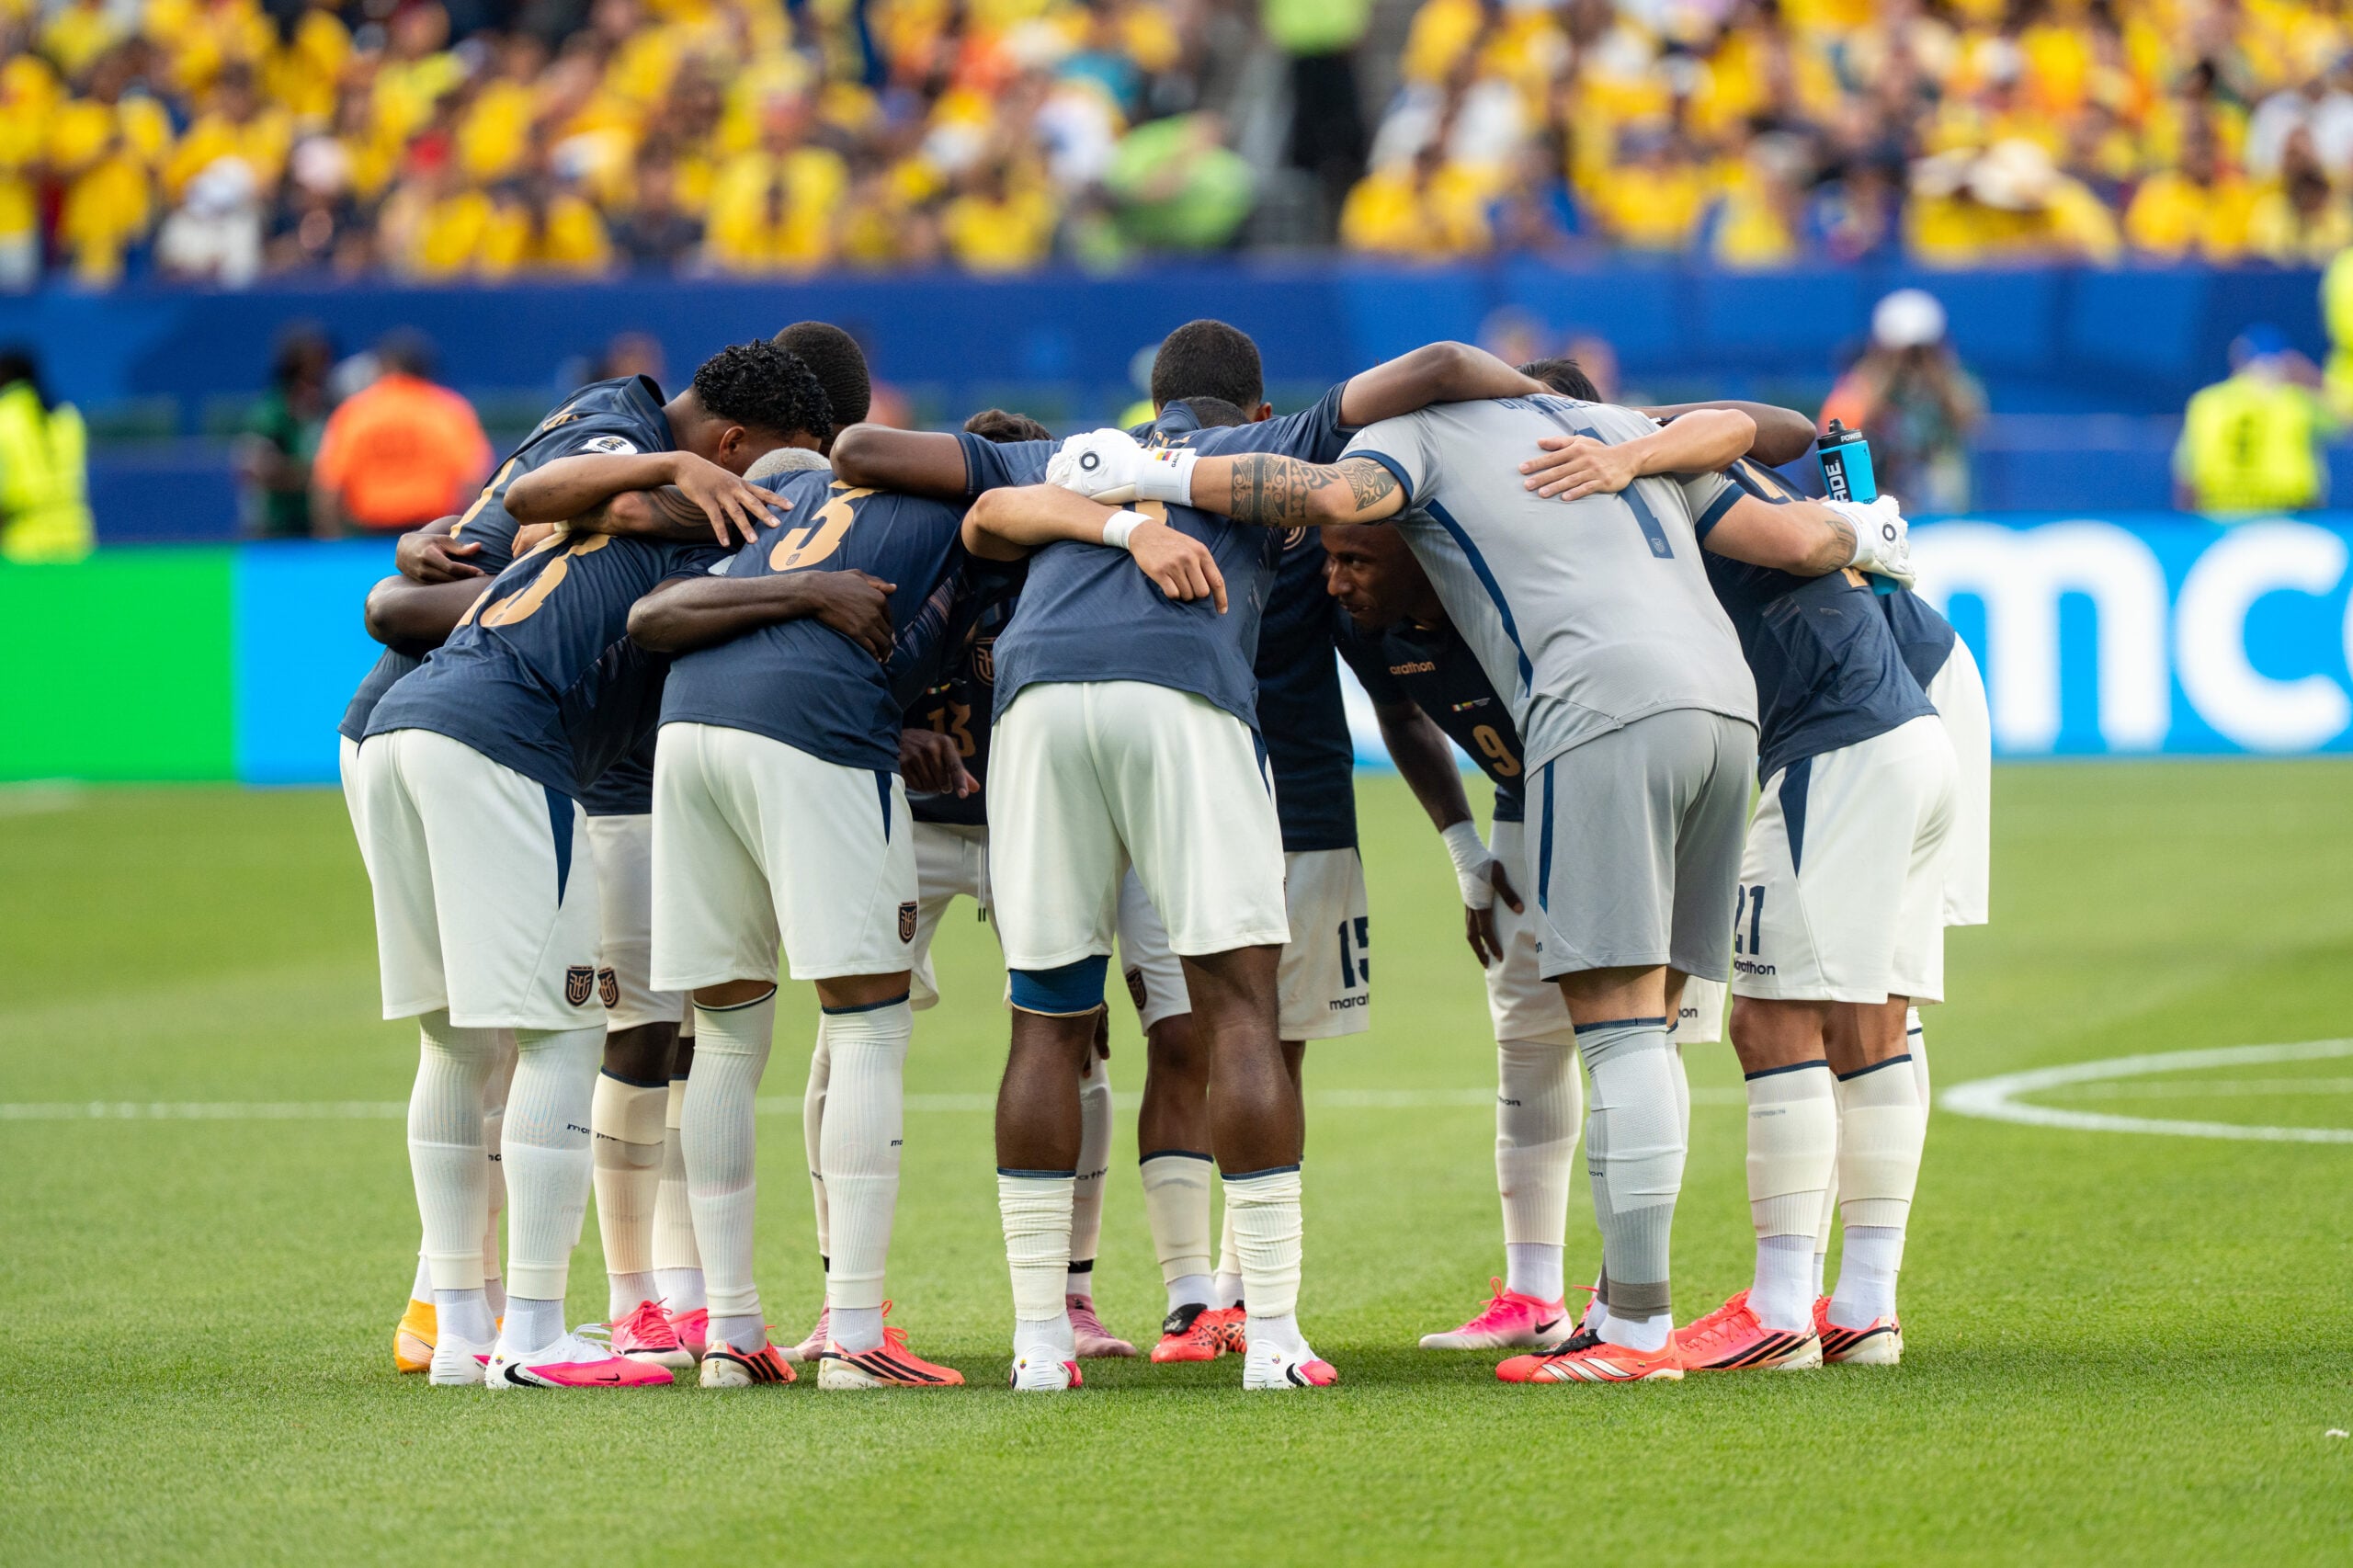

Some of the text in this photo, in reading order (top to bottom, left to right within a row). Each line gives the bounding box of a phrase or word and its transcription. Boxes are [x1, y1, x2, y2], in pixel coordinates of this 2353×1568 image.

[1908, 517, 2353, 754] mc
[1472, 724, 1521, 777] 9
[1337, 916, 1369, 989] 15
